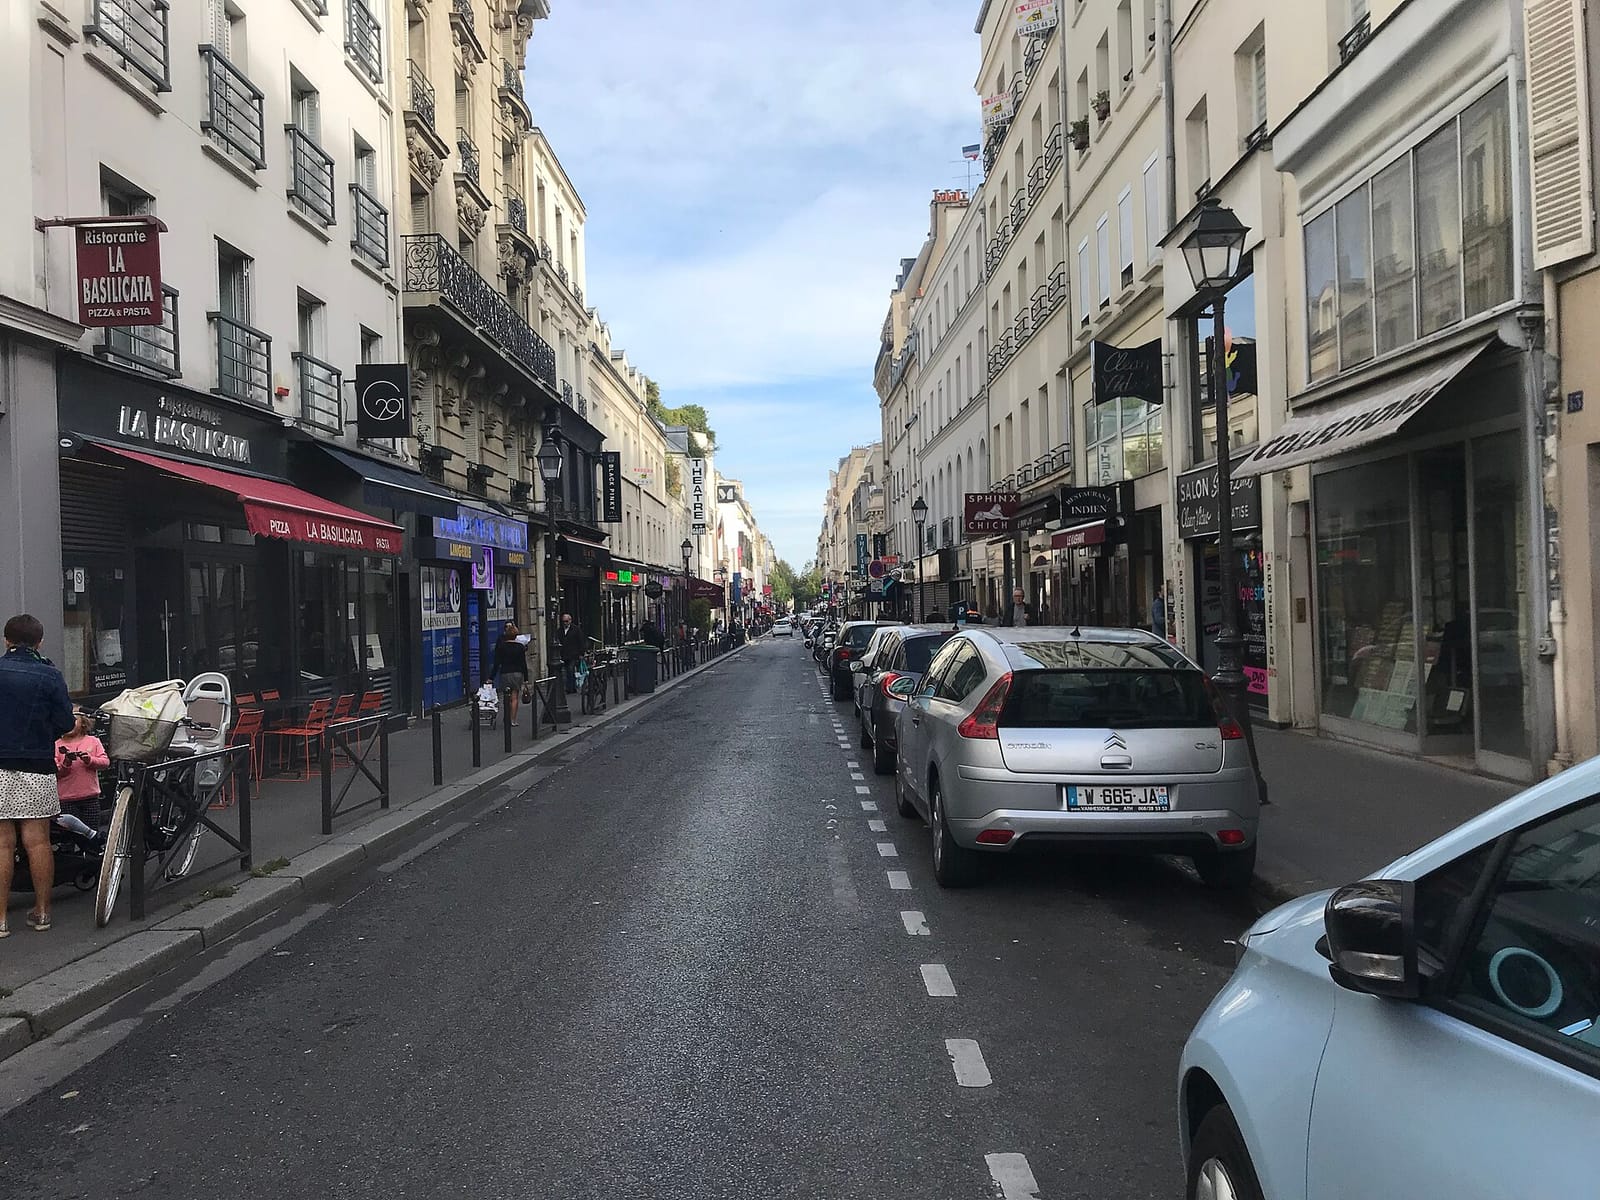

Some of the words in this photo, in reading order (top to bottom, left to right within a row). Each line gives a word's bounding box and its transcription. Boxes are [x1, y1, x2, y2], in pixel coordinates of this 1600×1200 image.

[84, 229, 147, 245] Ristorante
[108, 246, 127, 273] LA
[82, 276, 154, 305] BASILICATA
[88, 307, 116, 318] PIZZA
[123, 306, 152, 317] PASTA
[117, 404, 150, 440] LA
[154, 415, 251, 464] BASILICATA
[691, 459, 704, 520] THEATRE
[1180, 477, 1209, 502] SALON
[968, 494, 1017, 503] SPHINX
[1065, 491, 1111, 505] RESTAURANT
[1071, 504, 1107, 515] INDIEN
[968, 521, 1008, 530] CHICH
[269, 519, 291, 535] PIZZA
[305, 521, 319, 540] LA
[320, 523, 364, 545] BASILICATA
[375, 537, 391, 550] PASTA
[958, 606, 964, 616] P
[1102, 788, 1133, 804] 665
[1138, 788, 1158, 804] JA
